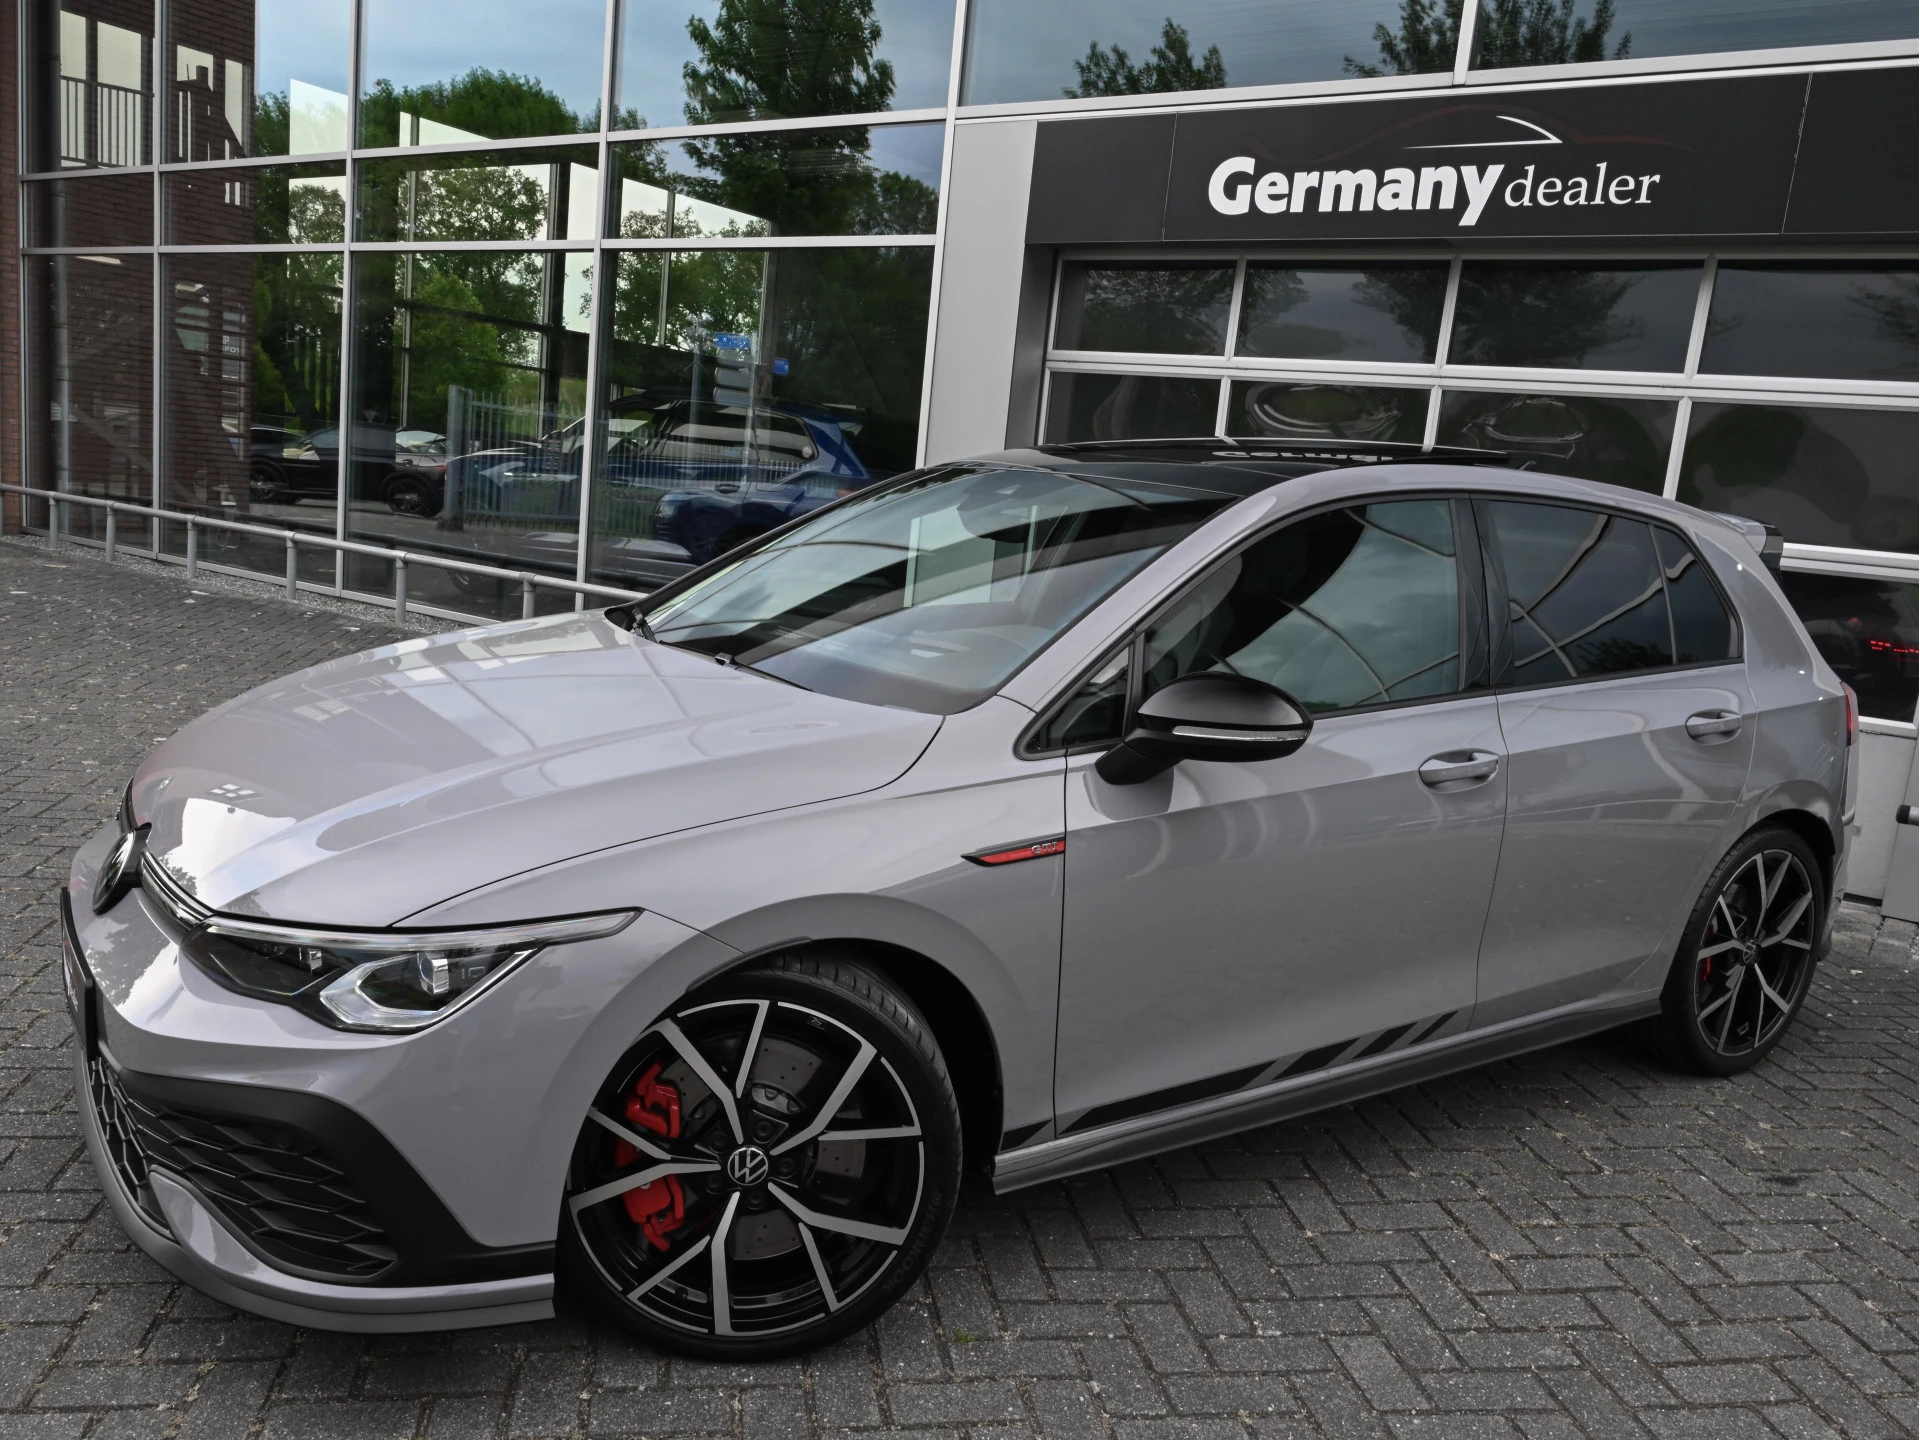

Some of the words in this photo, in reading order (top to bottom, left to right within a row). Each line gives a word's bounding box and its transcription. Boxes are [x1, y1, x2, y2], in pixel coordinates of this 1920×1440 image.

[1208, 156, 1505, 227] Germany
[1504, 161, 1661, 207] dealer
[1031, 841, 1058, 855] GTI
